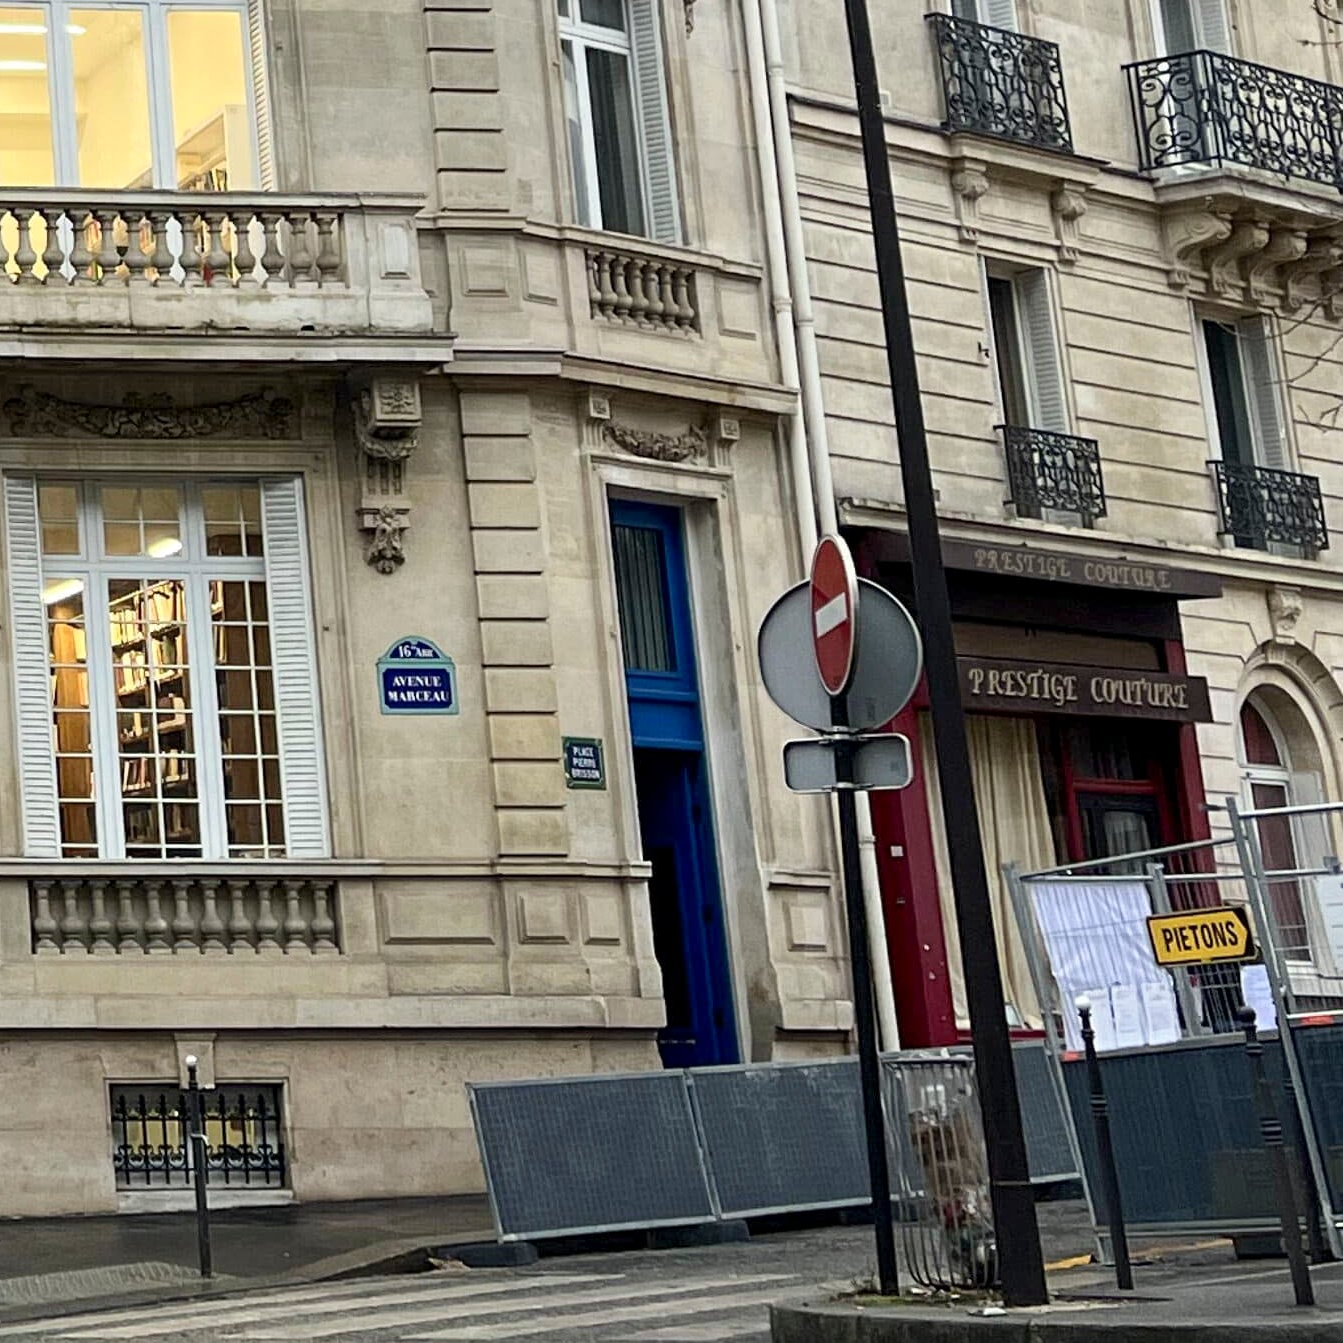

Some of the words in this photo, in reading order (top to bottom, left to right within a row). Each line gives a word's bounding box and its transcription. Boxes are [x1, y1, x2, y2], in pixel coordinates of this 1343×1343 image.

[975, 549, 1071, 580] PRESTIGE
[1084, 562, 1172, 591] COUTURE
[388, 690, 450, 702] MARCEAU
[392, 675, 442, 688] AVENUE
[968, 668, 1079, 706] PRESTIGE
[1090, 677, 1189, 709] COUTURE
[1161, 920, 1239, 953] PIETONS
